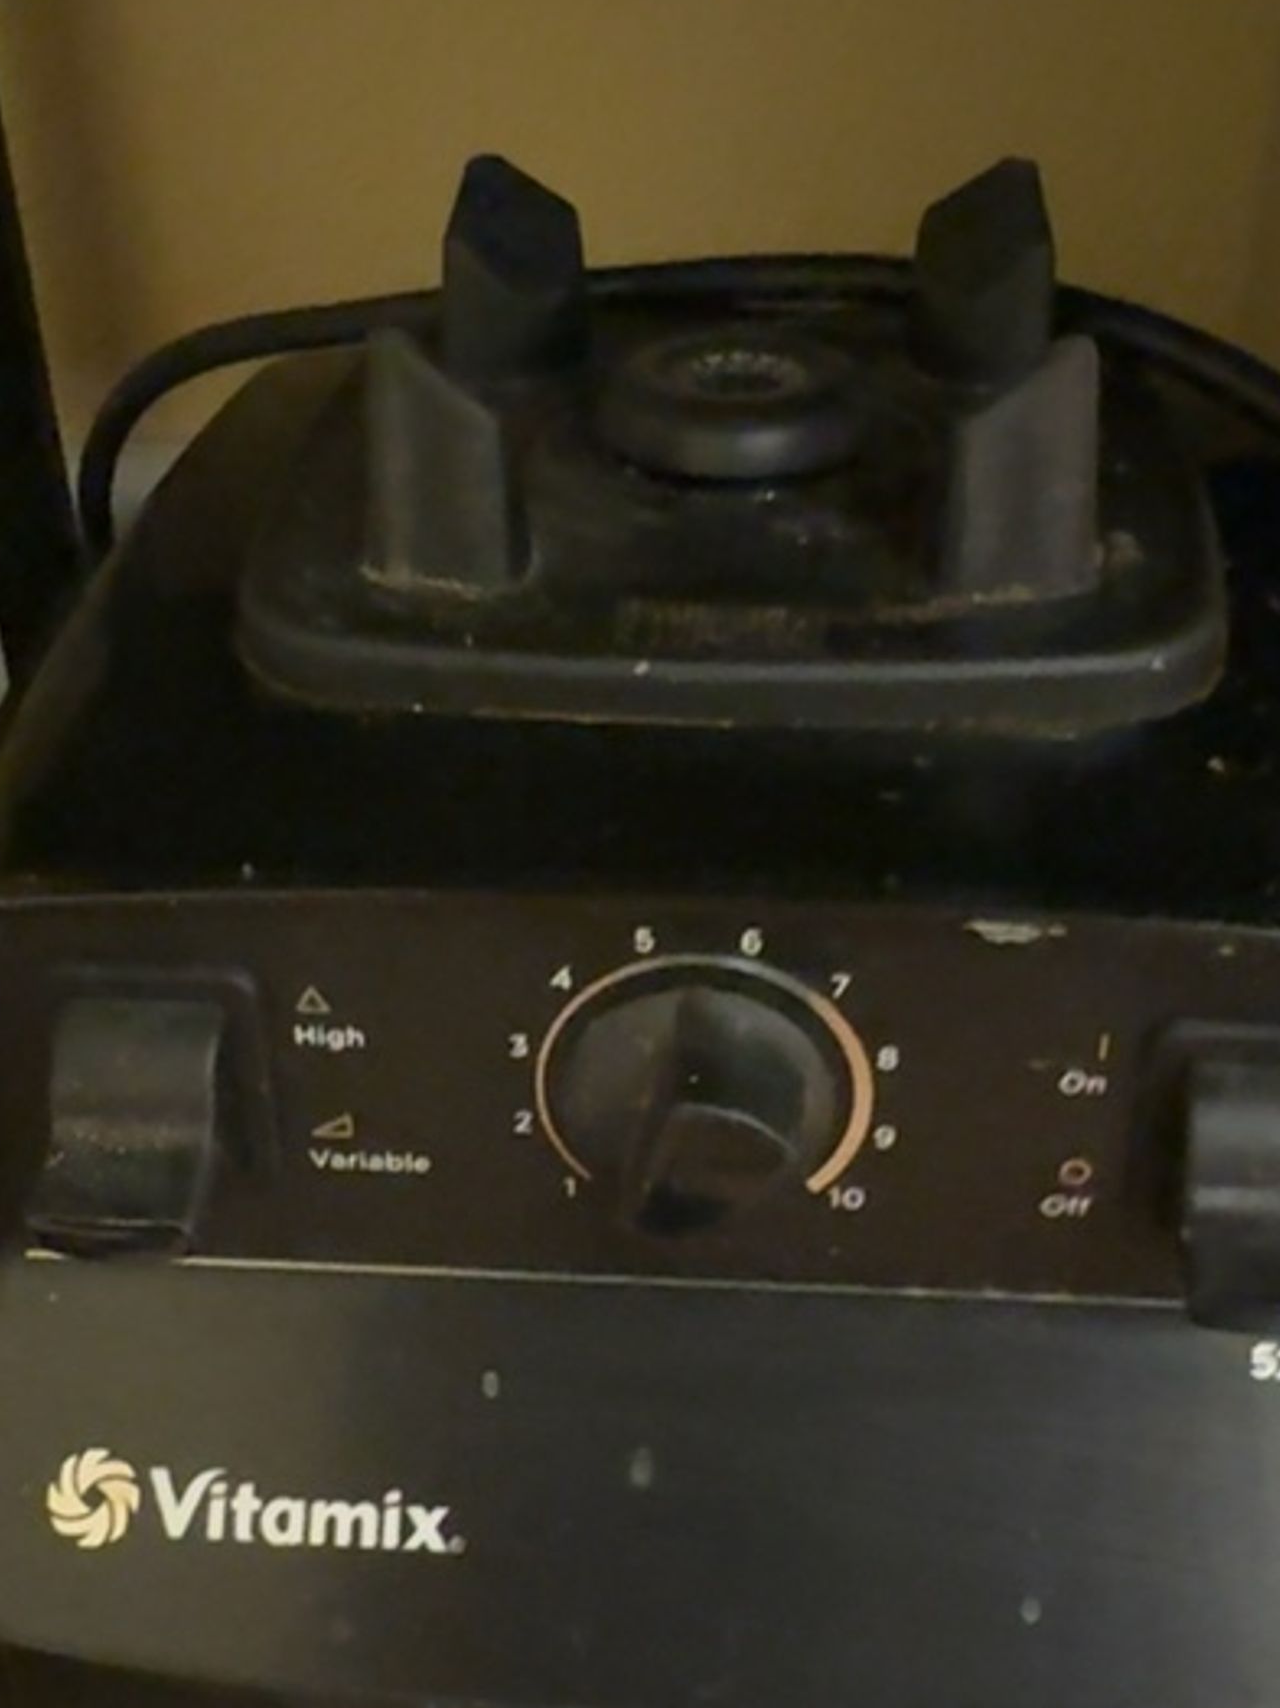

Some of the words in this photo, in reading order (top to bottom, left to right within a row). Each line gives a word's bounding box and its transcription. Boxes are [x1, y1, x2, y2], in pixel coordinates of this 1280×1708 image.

[633, 926, 656, 955] 5
[739, 927, 765, 958] 6
[549, 965, 574, 991] 4
[830, 972, 852, 998] 7
[293, 1022, 366, 1051] High
[508, 1033, 529, 1059] 3
[876, 1044, 900, 1072] 8
[1057, 1067, 1108, 1096] On
[512, 1110, 533, 1135] 2
[873, 1126, 897, 1152] 9
[308, 1146, 432, 1174] Variable
[564, 1177, 577, 1198] 1
[829, 1187, 866, 1211] 10
[1038, 1195, 1094, 1219] Off
[149, 1465, 451, 1554] Vitamix
